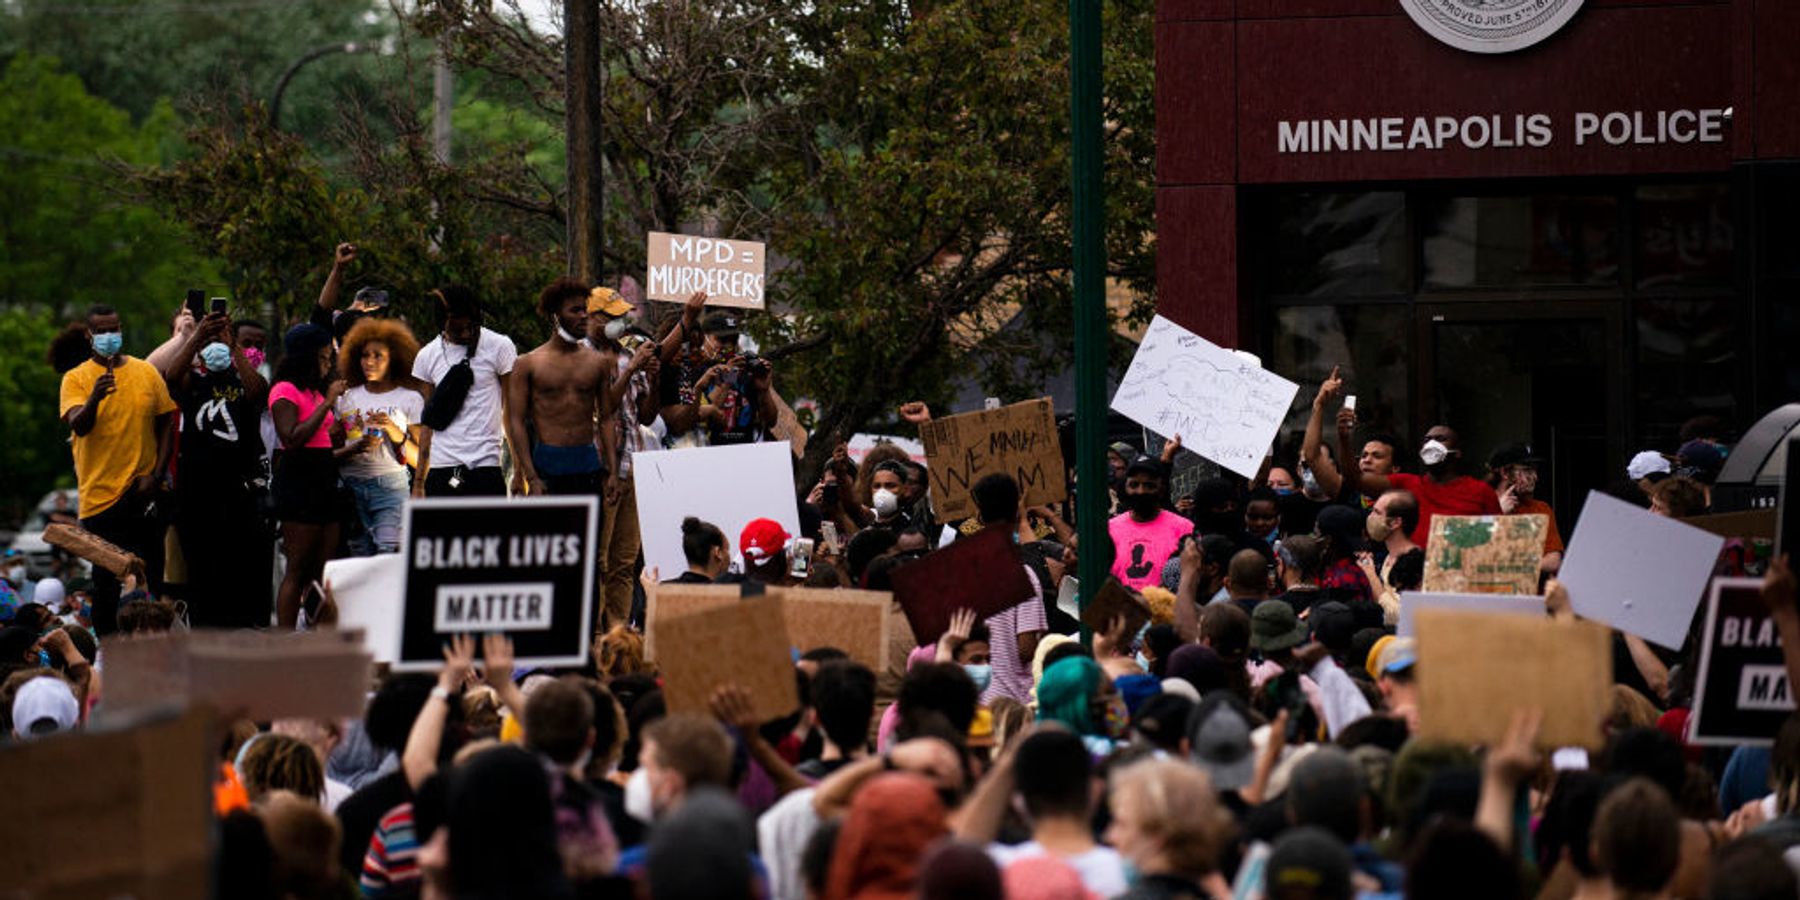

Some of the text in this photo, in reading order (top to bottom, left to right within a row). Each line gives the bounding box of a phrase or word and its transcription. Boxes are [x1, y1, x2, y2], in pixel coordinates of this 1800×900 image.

[1484, 14, 1512, 25] JUNE
[1277, 108, 1723, 153] MINNEAPOLIS POLICE
[670, 238, 734, 264] MPD
[649, 263, 765, 304] MURDERERS
[930, 437, 987, 499] WE
[414, 533, 581, 569] BLACK LIVES
[445, 594, 543, 623] MATTER
[1721, 616, 1783, 648] BLA
